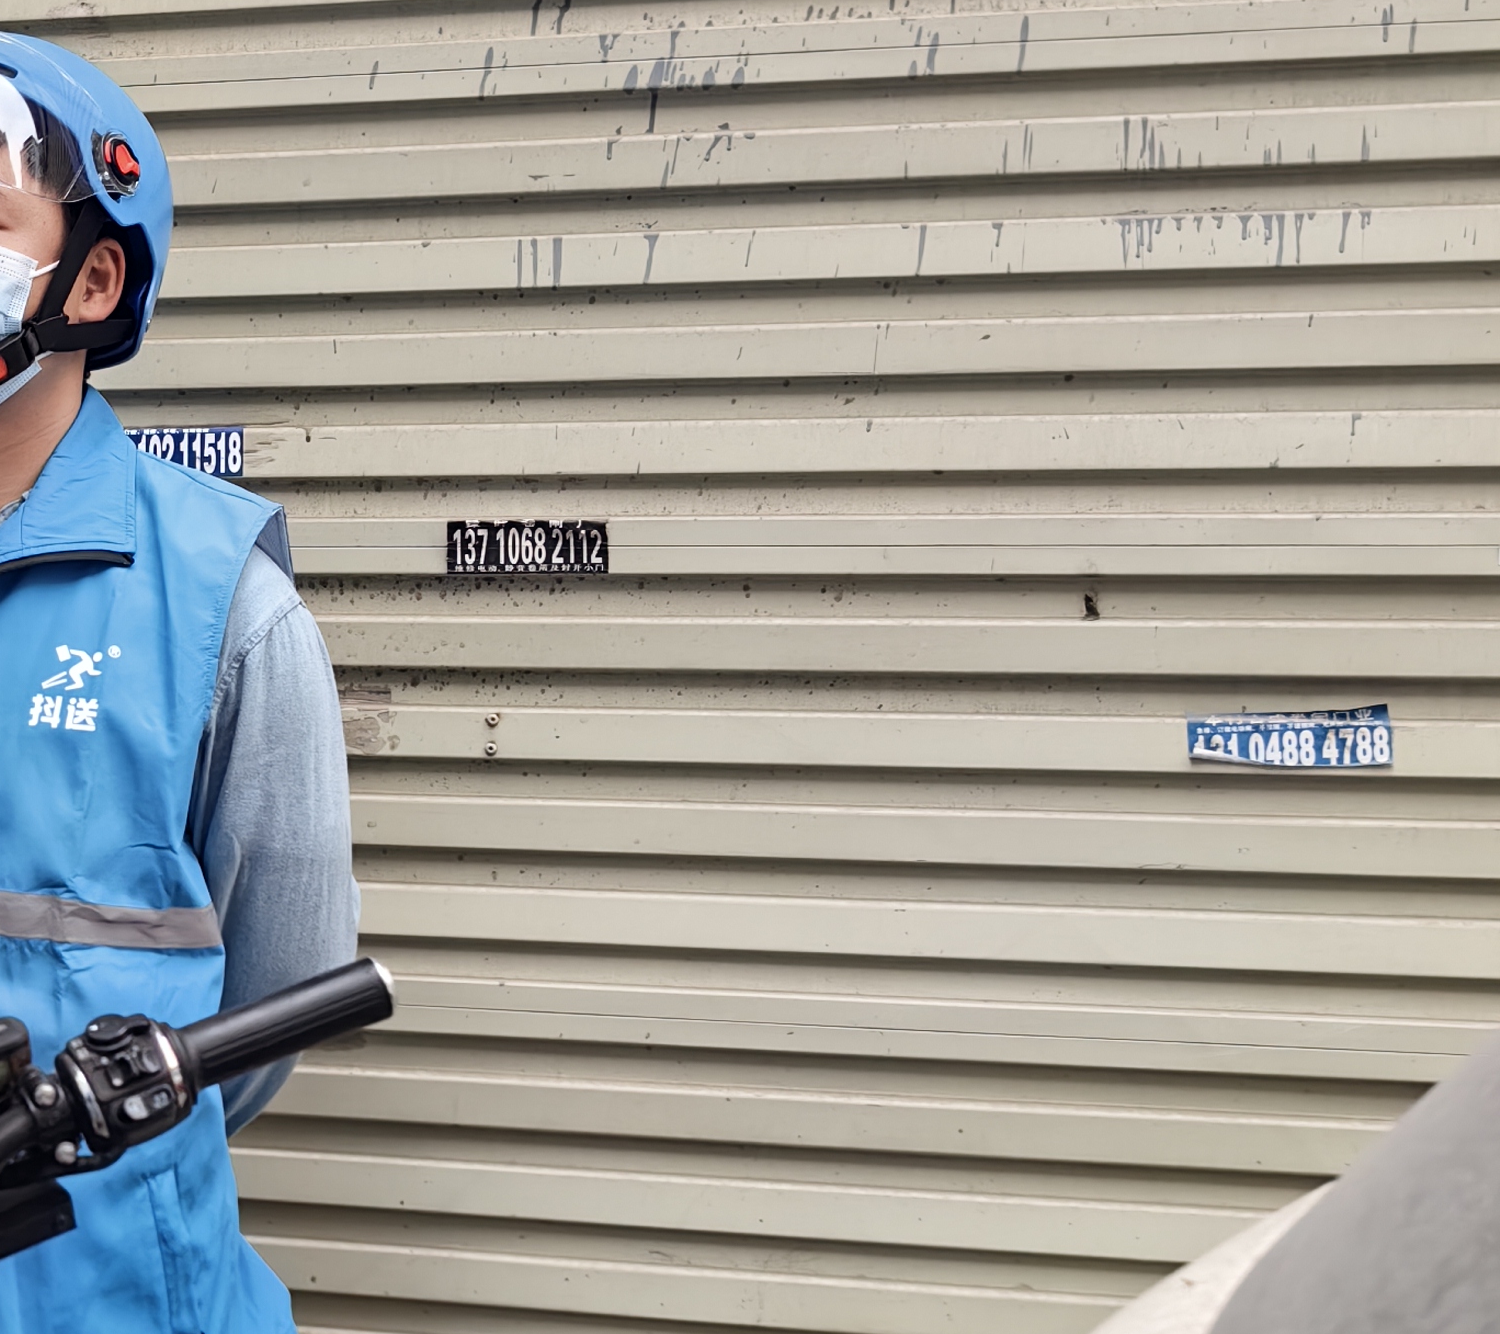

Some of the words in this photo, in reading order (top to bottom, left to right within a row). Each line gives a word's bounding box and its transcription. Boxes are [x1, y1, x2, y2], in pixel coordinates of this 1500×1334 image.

[180, 431, 242, 474] 11518
[453, 528, 489, 565] 137
[496, 527, 547, 565] 1068
[551, 528, 603, 565] 2112
[28, 693, 99, 732] 抖送
[1248, 729, 1316, 767] 0488
[1322, 725, 1390, 766] 4788
